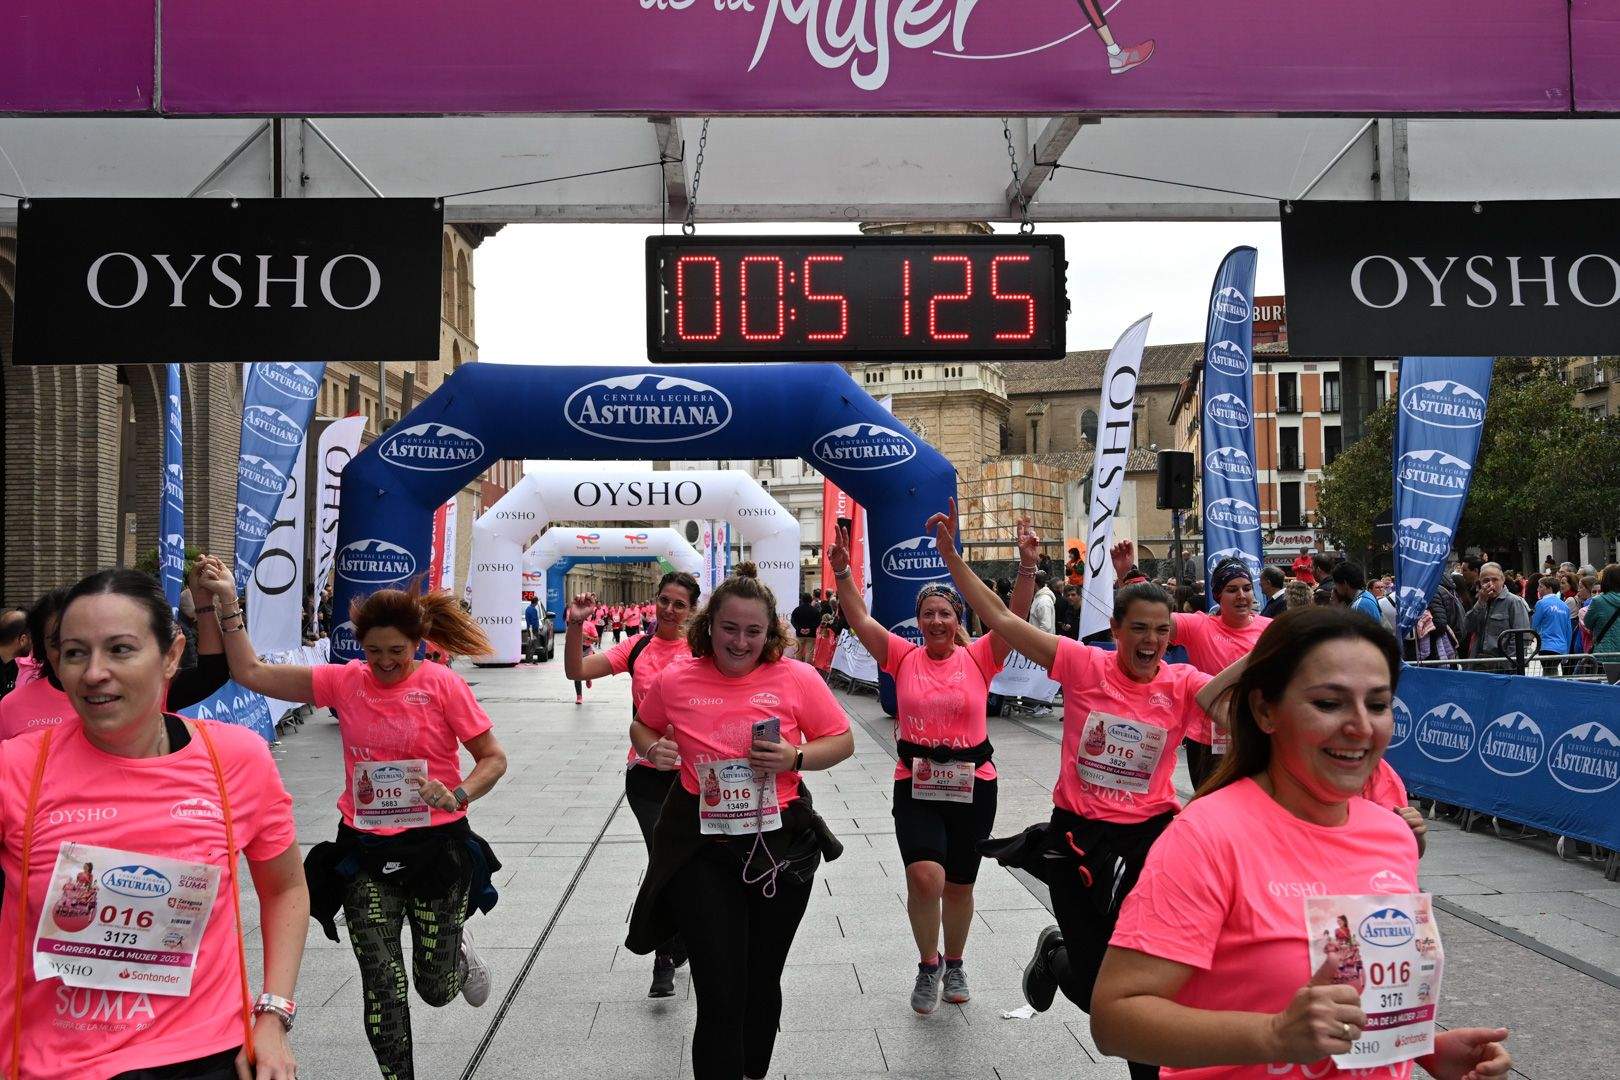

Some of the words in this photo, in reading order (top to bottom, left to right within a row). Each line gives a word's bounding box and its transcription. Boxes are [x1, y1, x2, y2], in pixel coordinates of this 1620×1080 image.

[87, 252, 381, 310] OYSHO
[1350, 253, 1620, 310] OYSHO
[1253, 305, 1286, 321] BUR
[260, 363, 314, 397] ASTURIANA
[603, 394, 655, 402] CENTRAL
[661, 394, 714, 402] LECHERA
[1407, 392, 1482, 421] ASTURIANA
[577, 395, 720, 425] ASTURIANA
[244, 411, 299, 443] ASTURIANA
[385, 440, 476, 460] ASTURIANA
[821, 442, 911, 460] ASTURIANA
[238, 465, 283, 492] STURIANA
[1089, 365, 1137, 578] OYSHO
[574, 480, 702, 507] OYSHO
[496, 511, 535, 520] OYSHO
[738, 508, 776, 517] OYSHO
[338, 554, 410, 573] ASTURIANA
[477, 563, 514, 573] OYSHO
[758, 561, 794, 570] OYSHO
[887, 555, 947, 571] ASTURIA
[476, 615, 513, 625] OYSHO
[688, 697, 724, 706] OYSHO
[27, 716, 63, 727] OYSHO
[1418, 720, 1470, 751] ASTURIANA
[1106, 744, 1135, 760] 016
[1482, 731, 1537, 764] ASTURIANA
[1109, 757, 1127, 768] 3829
[1551, 743, 1618, 780] ASTURIANA
[933, 770, 954, 779] 016
[376, 787, 402, 798] 016
[723, 788, 751, 800] 016
[727, 802, 749, 810] 13499
[49, 807, 118, 825] OYSHO
[106, 873, 165, 895] ASTURIANA
[178, 880, 207, 890] SUMA
[1268, 880, 1328, 897] OYSHO
[100, 905, 154, 928] 016
[104, 930, 138, 945] 3173
[52, 943, 97, 955] CARRERA
[98, 949, 112, 957] DE
[112, 950, 126, 959] LA
[126, 952, 158, 961] MUJER
[160, 954, 180, 963] 2023
[132, 970, 181, 984] Santander
[1370, 961, 1411, 986] 016
[55, 985, 156, 1021] SUMA
[1354, 1041, 1380, 1054] SHO
